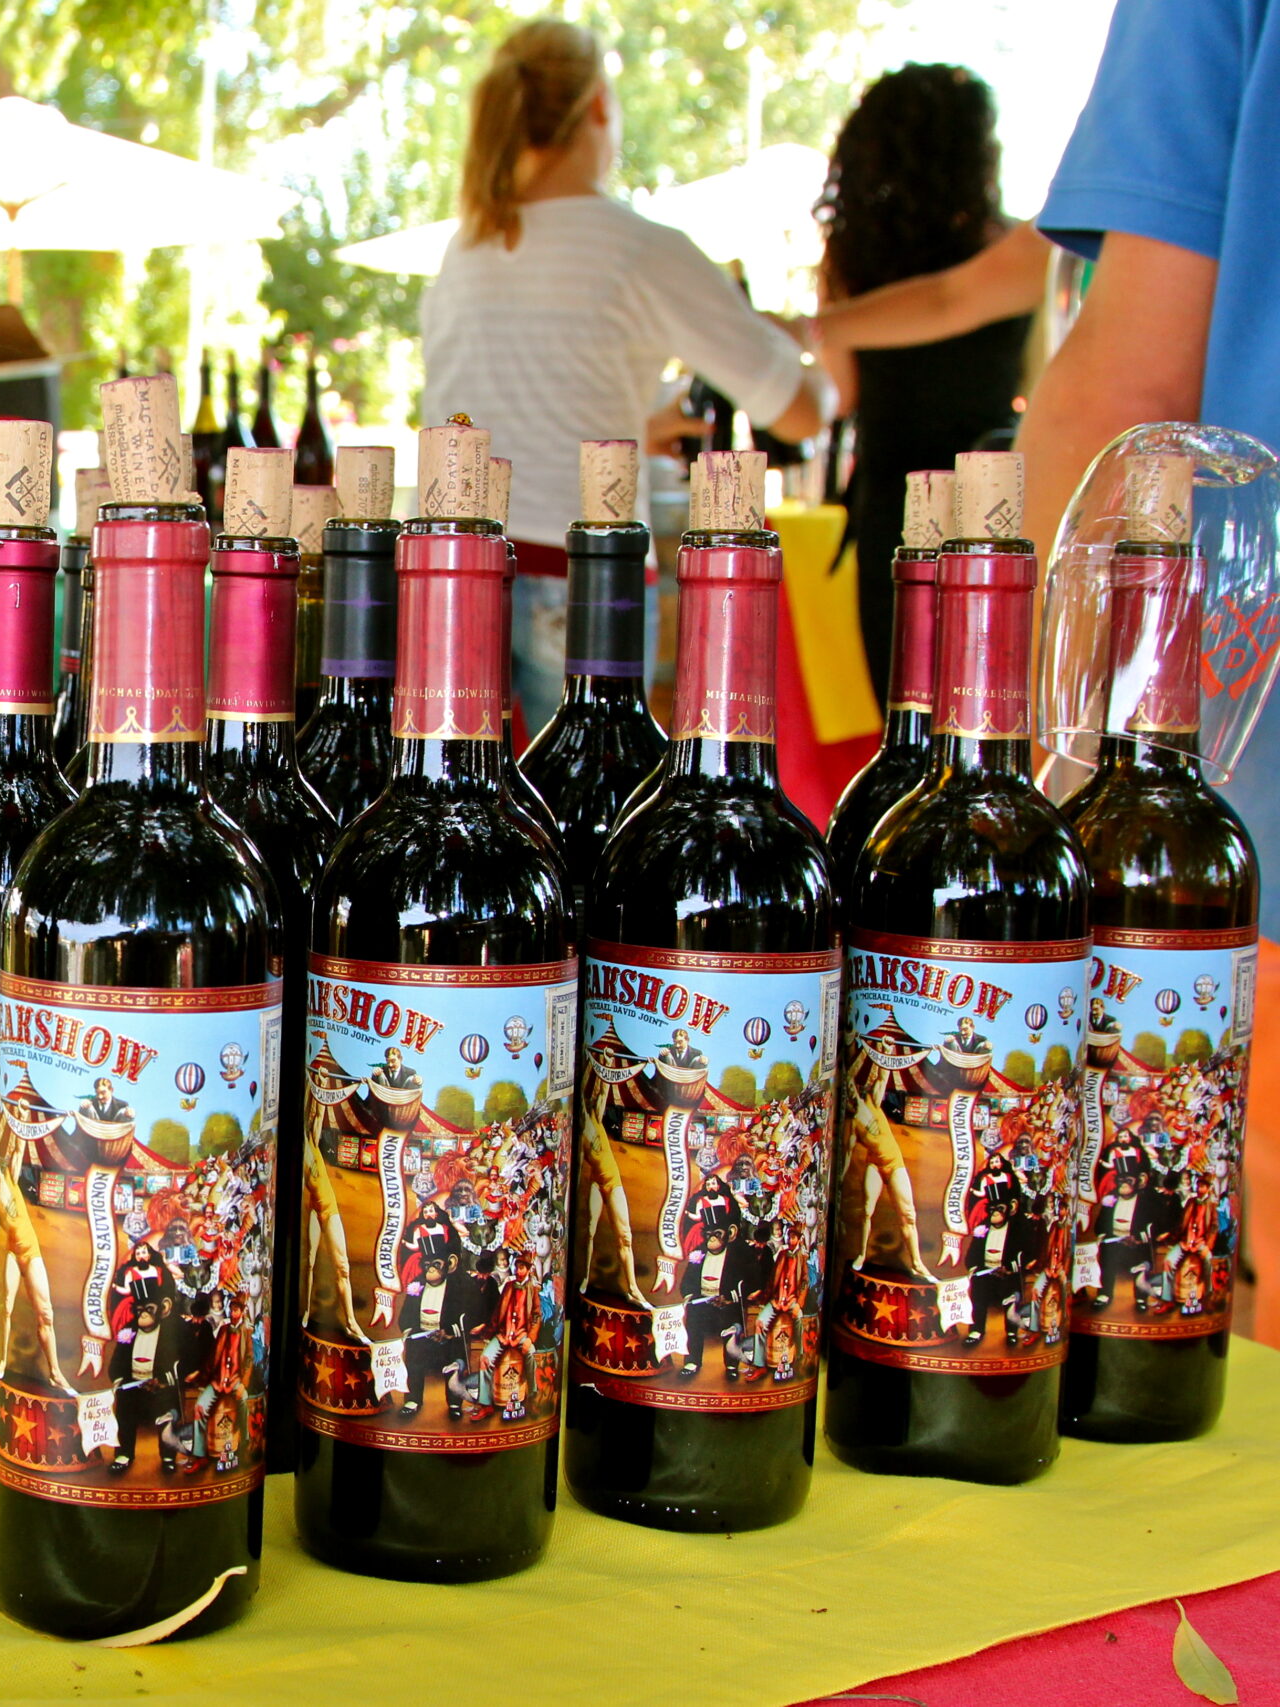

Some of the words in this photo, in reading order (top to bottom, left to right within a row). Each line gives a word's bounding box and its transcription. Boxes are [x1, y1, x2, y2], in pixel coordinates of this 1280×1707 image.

[447, 438, 458, 490] DAVID
[428, 687, 466, 699] DAVID
[705, 689, 759, 704] MICHAEL
[892, 995, 920, 1010] DAVID
[612, 1006, 636, 1019] DAVID
[326, 1020, 350, 1037] DAVID
[27, 1051, 54, 1066] DAVID
[1083, 1071, 1102, 1142] SAUVIGNON
[955, 1095, 972, 1162] SAUVIGNON
[670, 1111, 687, 1185] SAUVIGNON
[384, 1134, 403, 1209] SAUVIGNON
[1080, 1142, 1100, 1193] CABERNET
[947, 1163, 970, 1224] CABERNET
[92, 1171, 115, 1252] SAUVIGNON
[664, 1185, 685, 1249] CABERNET
[381, 1210, 401, 1280] CABERNET
[942, 1235, 960, 1250] 2010
[657, 1259, 674, 1275] 2010
[89, 1254, 114, 1327] CABERNET
[942, 1290, 967, 1304] 14.5%
[374, 1292, 394, 1308] 2010
[950, 1302, 962, 1312] By
[658, 1310, 674, 1321] Alc.
[656, 1319, 682, 1332] 14.5%
[664, 1331, 677, 1342] By
[82, 1340, 103, 1357] 2010
[377, 1346, 393, 1357] Alc.
[664, 1341, 680, 1351] Vol.
[375, 1354, 401, 1369] 14.5%
[383, 1367, 396, 1379] By
[384, 1378, 400, 1389] Vol.
[83, 1406, 112, 1421] 14.5%
[93, 1420, 106, 1432] By
